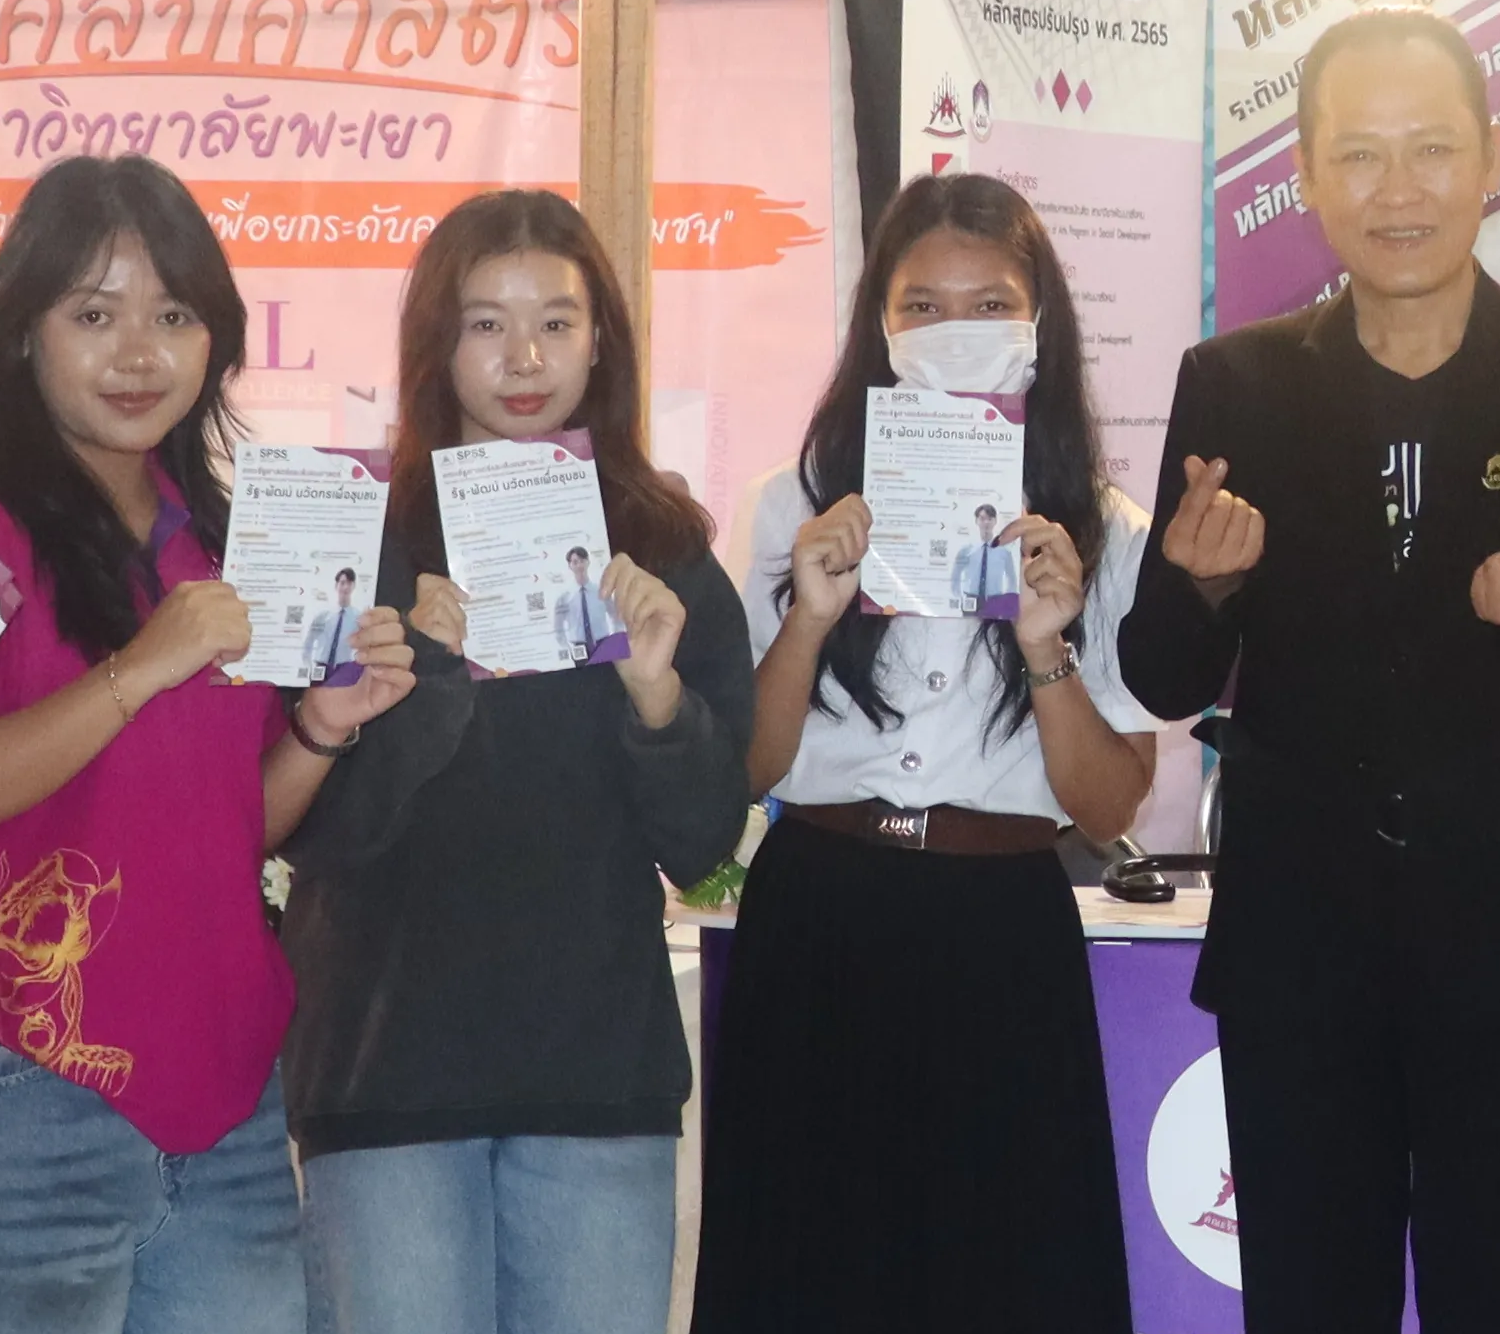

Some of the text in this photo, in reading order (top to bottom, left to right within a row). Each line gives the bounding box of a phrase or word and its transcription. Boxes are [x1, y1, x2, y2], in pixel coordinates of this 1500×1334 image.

[983, 0, 1169, 47] หลักสูตรปรับปรุง พ.ศ. 2565
[890, 392, 920, 404] SPSS
[260, 448, 288, 459] SPSS
[456, 447, 486, 461] SPSS
